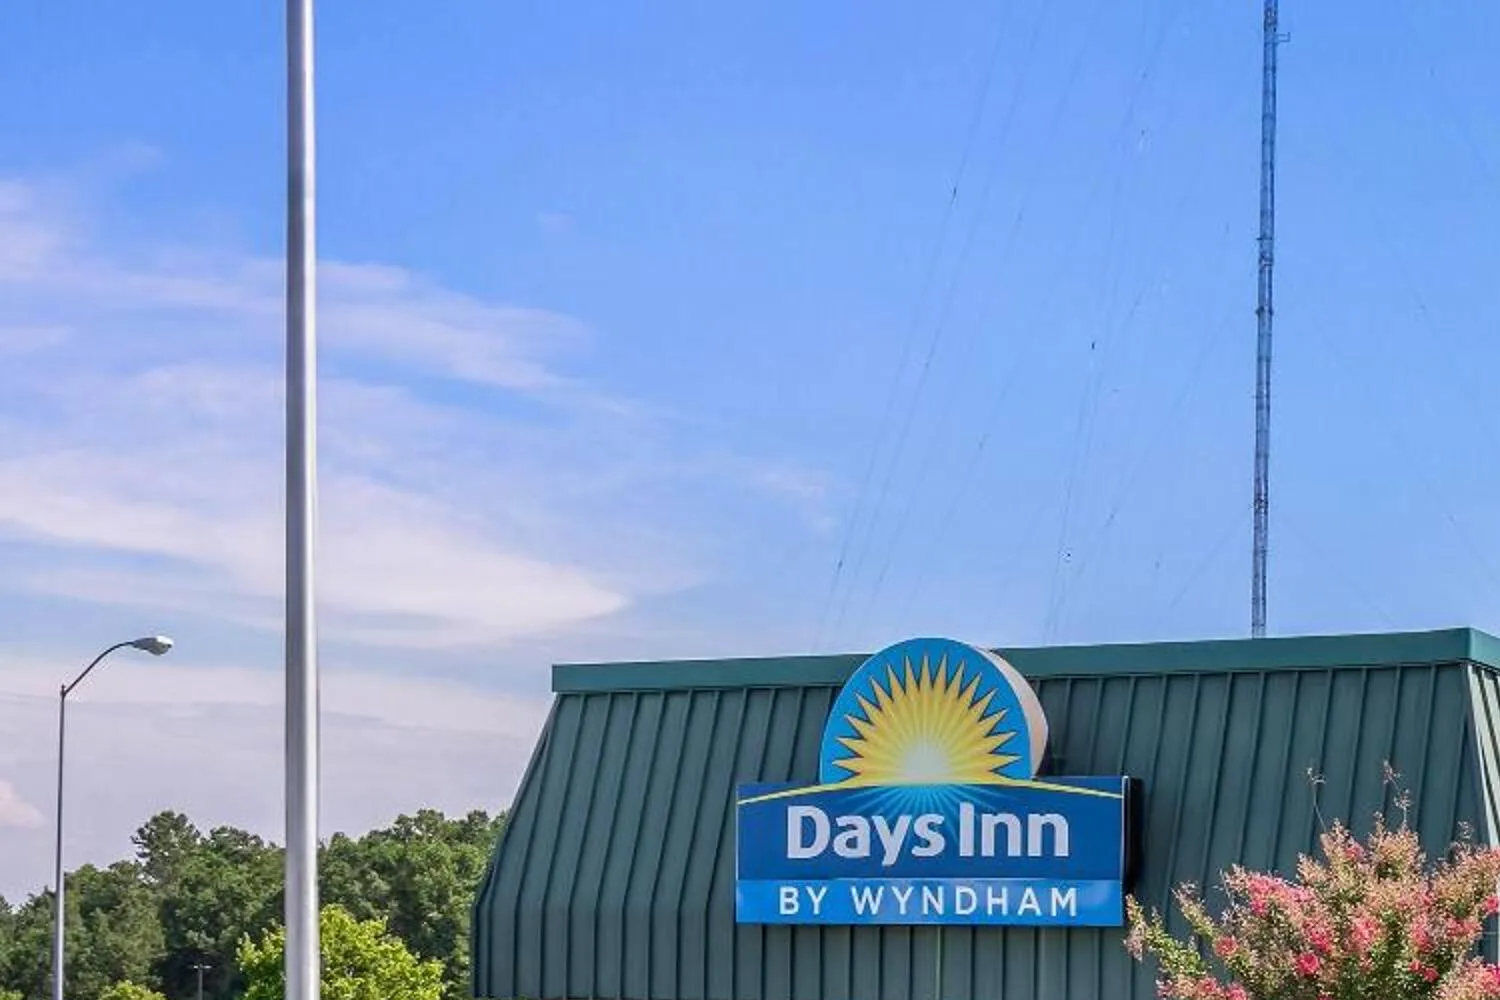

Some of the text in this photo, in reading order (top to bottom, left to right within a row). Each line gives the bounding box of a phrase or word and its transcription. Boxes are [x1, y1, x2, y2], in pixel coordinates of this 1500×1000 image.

[787, 802, 1070, 867] Days Inn
[779, 886, 1078, 917] BY WYNDHAM
